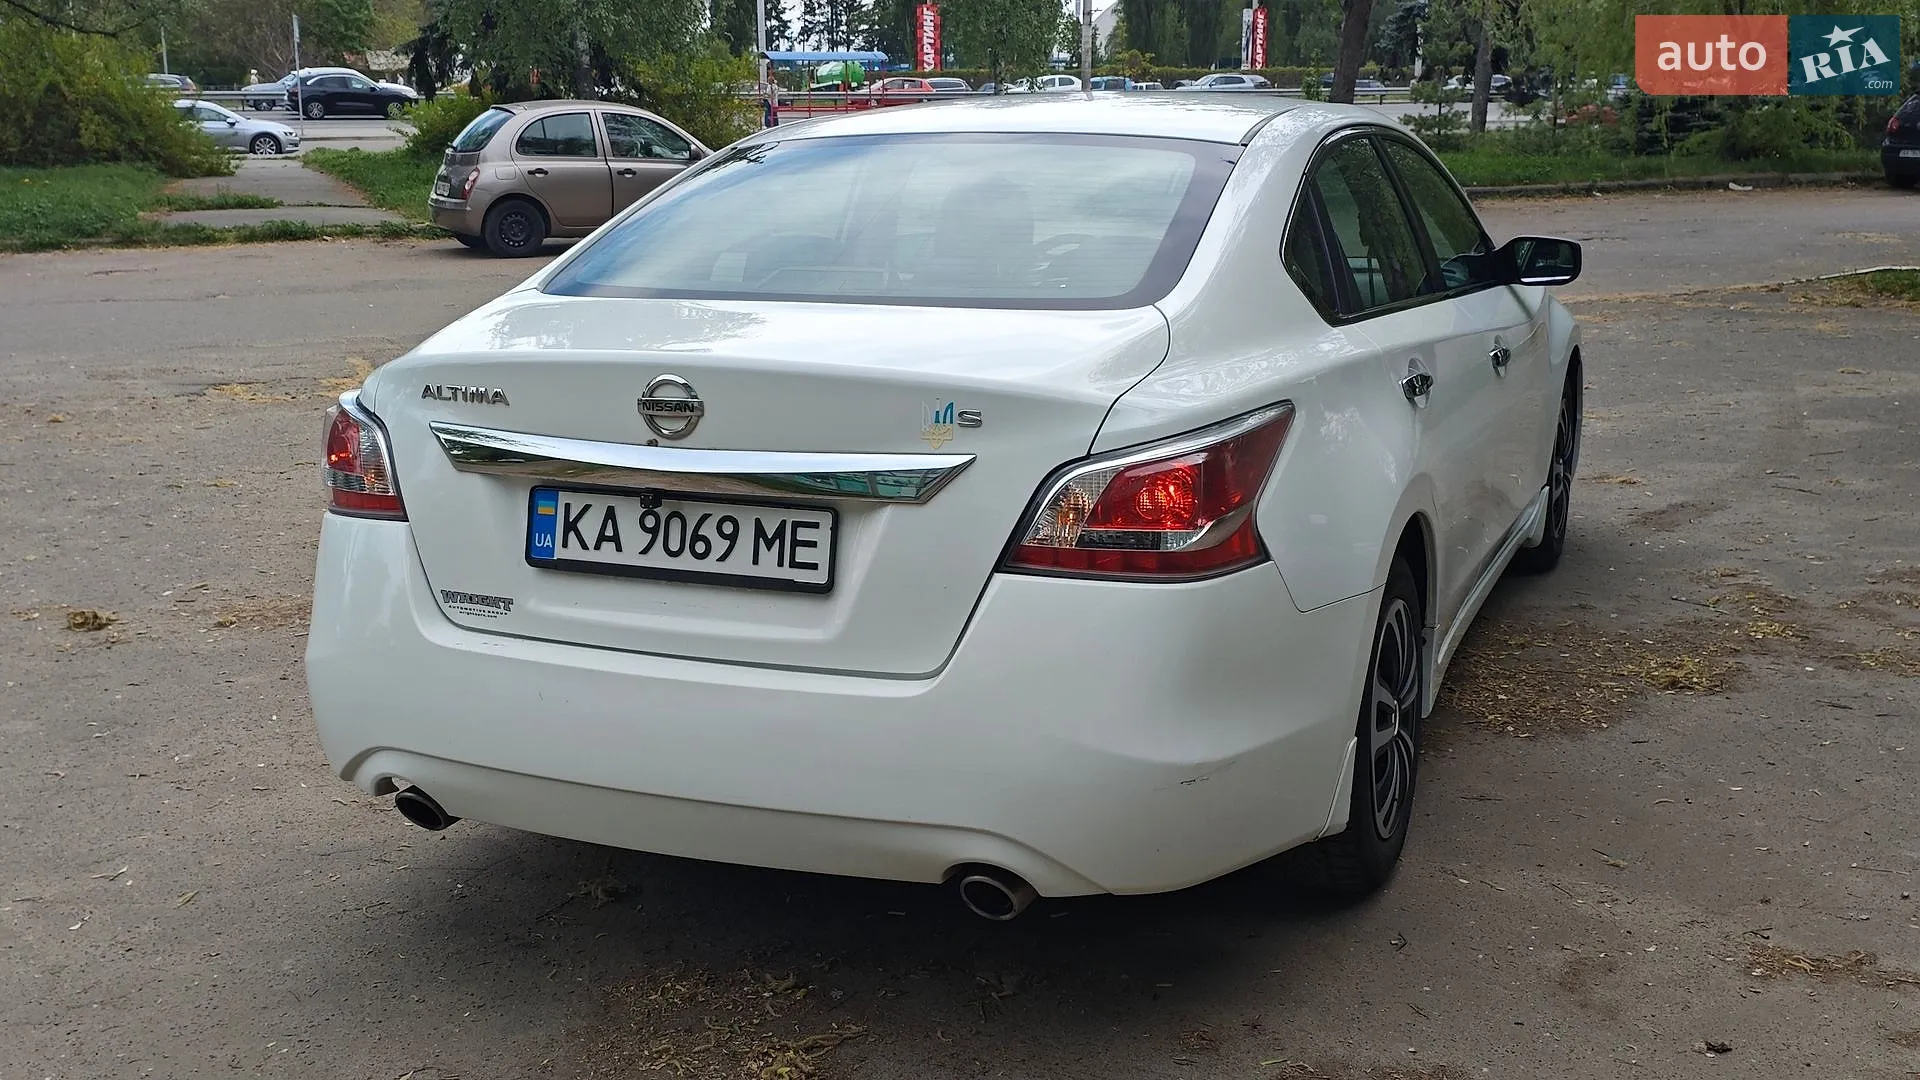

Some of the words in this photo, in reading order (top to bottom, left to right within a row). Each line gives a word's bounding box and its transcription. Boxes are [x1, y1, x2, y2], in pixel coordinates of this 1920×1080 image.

[421, 384, 510, 406] ALTIMA
[642, 401, 695, 413] NISSAN
[957, 409, 983, 428] S
[535, 533, 553, 548] UA
[562, 502, 622, 552] KA
[638, 509, 740, 562] 9069
[752, 517, 820, 570] ME
[441, 590, 513, 612] WRIGHT
